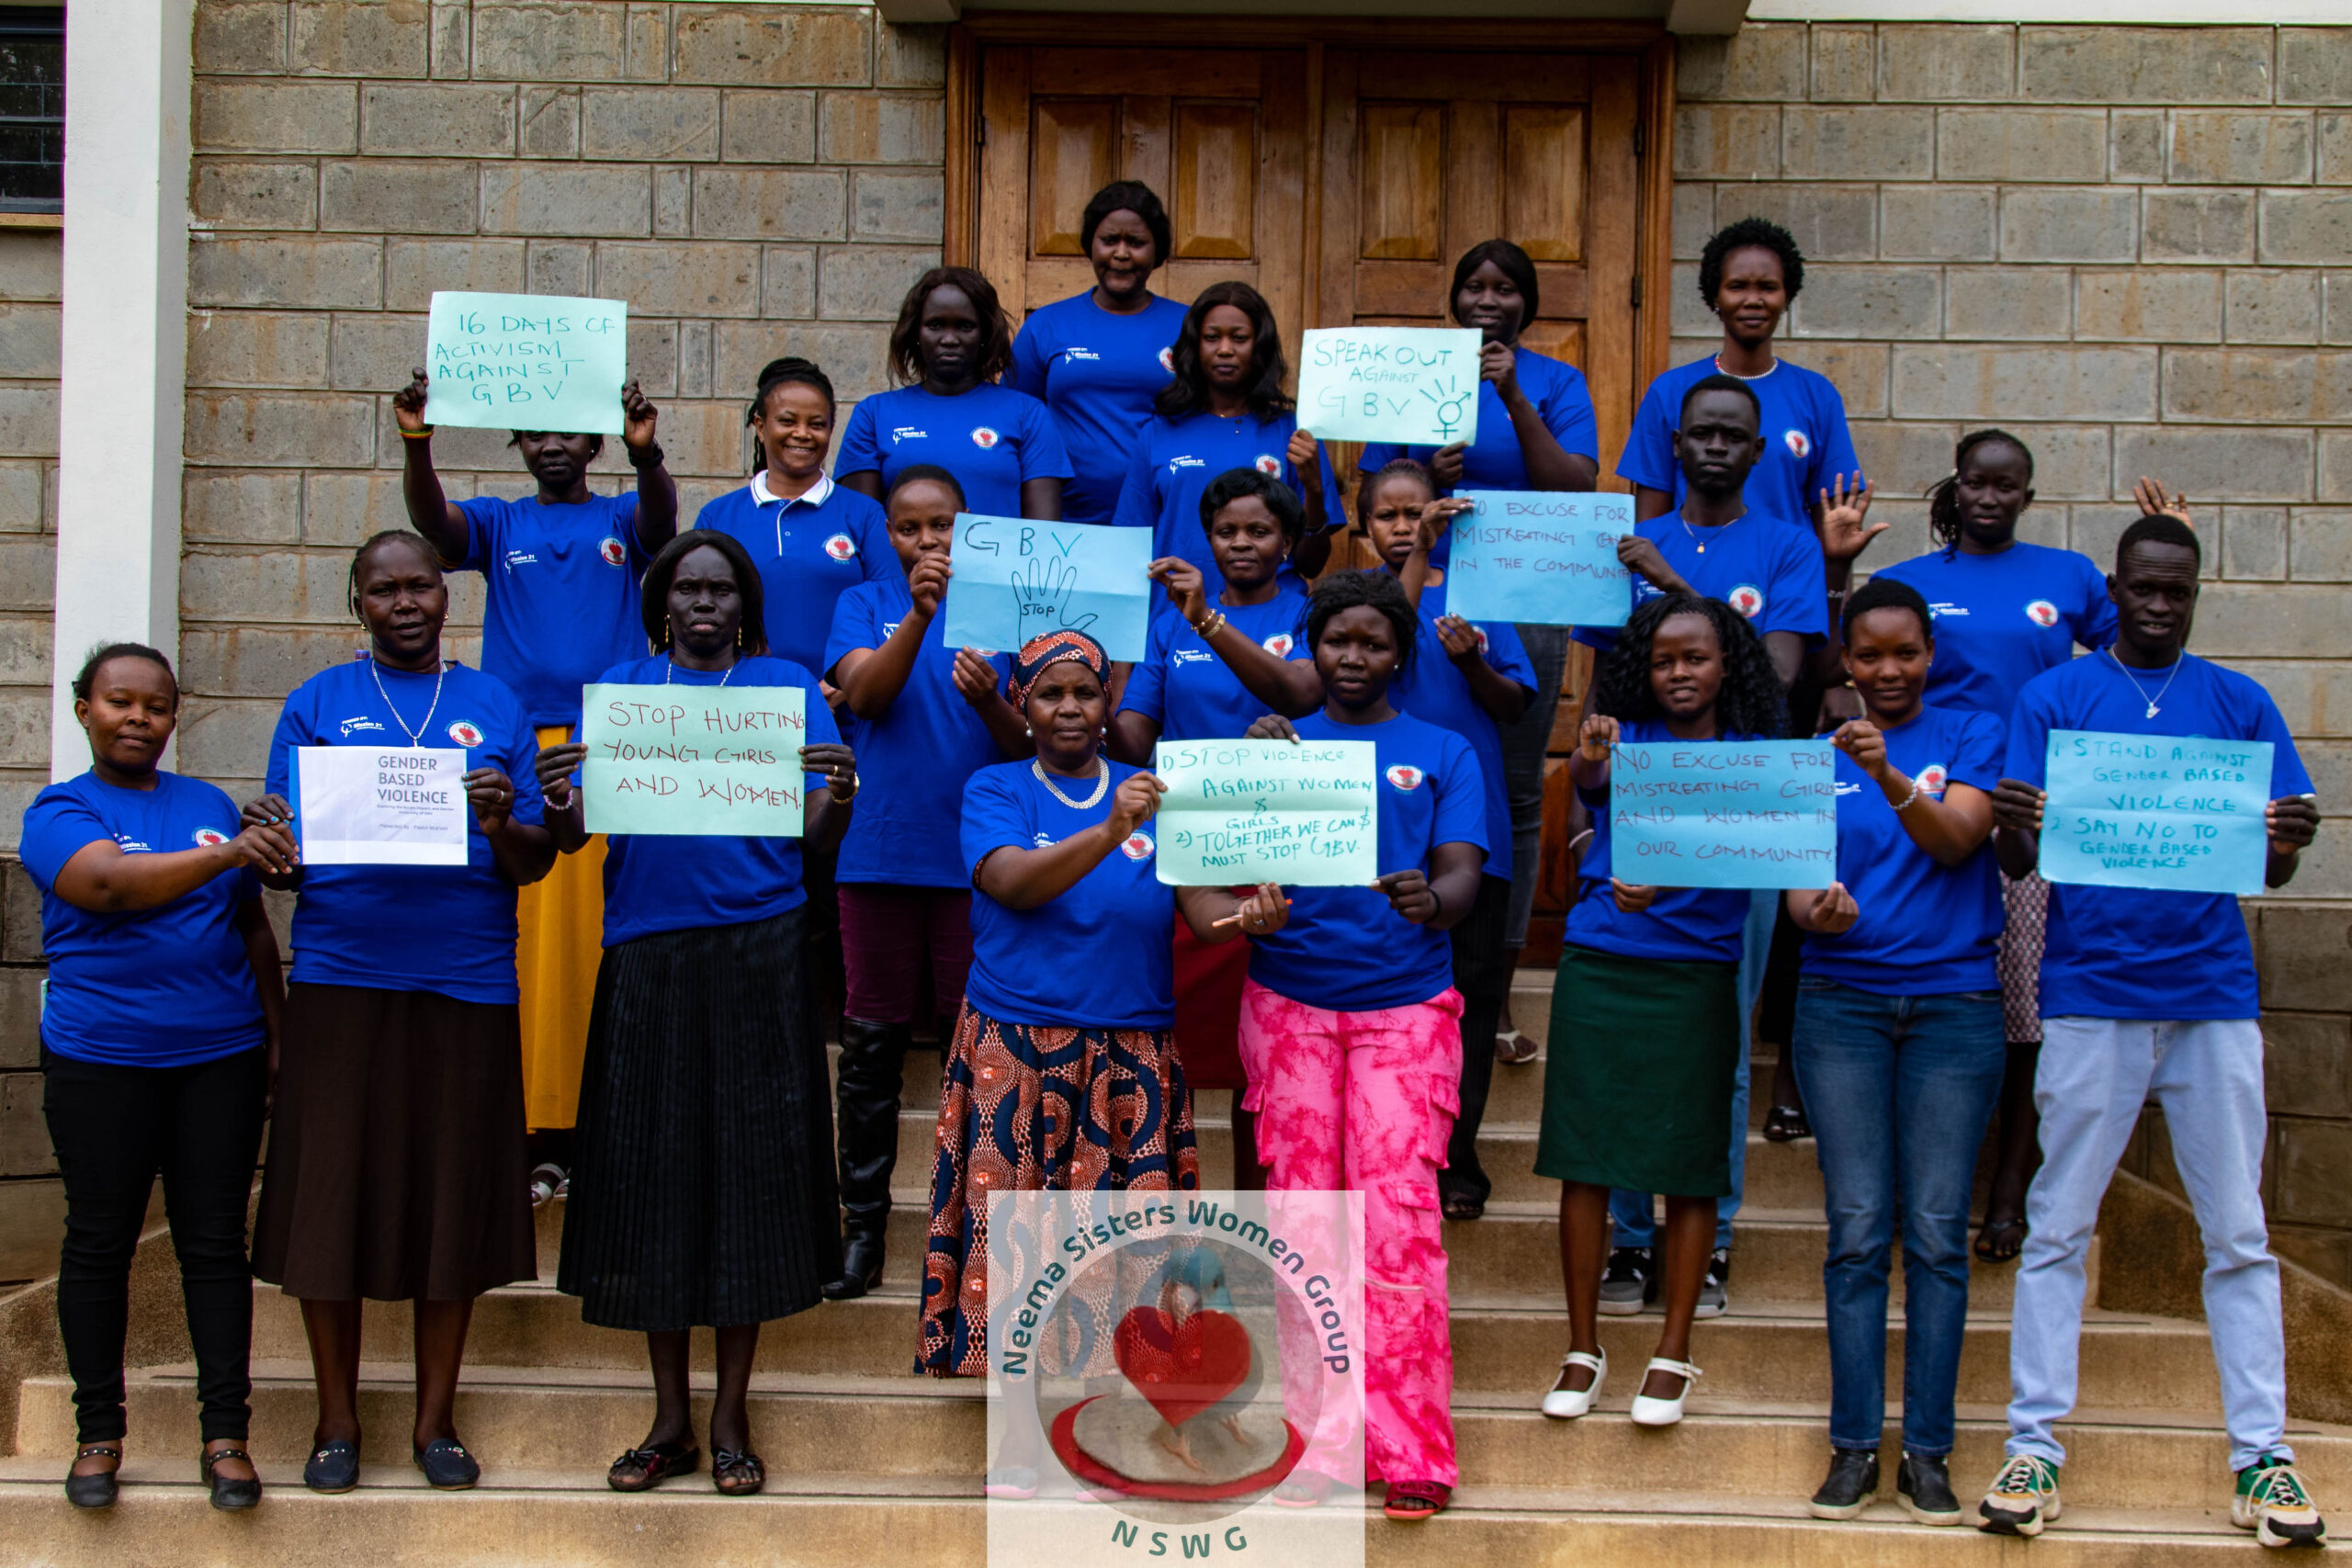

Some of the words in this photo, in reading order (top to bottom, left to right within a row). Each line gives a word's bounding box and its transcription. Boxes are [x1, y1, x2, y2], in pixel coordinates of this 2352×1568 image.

[460, 311, 485, 334] 16
[502, 316, 571, 334] DAYS
[435, 340, 561, 361] ACTIVISM
[1314, 339, 1389, 367] SPEAK
[1396, 347, 1453, 367] OUT
[439, 359, 584, 381] AGAINST
[1349, 367, 1419, 383] AGAINST
[1506, 502, 1579, 517] EXCUSE
[1594, 505, 1630, 523] FOR
[1456, 525, 1576, 546] MISTREATING
[1455, 558, 1478, 571] IN
[1493, 558, 1523, 570] THE
[1022, 604, 1056, 617] STOP
[608, 701, 685, 737] STOP
[704, 707, 805, 734] HURTING
[604, 739, 698, 763] YOUNG
[715, 748, 776, 765] GIRLS
[1261, 750, 1345, 762] VIOLENCE
[1615, 749, 1651, 773] NO
[1672, 751, 1771, 770] EXCUSE
[1791, 751, 1833, 770] FOR
[2074, 738, 2158, 759] STAND
[2171, 746, 2252, 767] AGAINST
[379, 755, 437, 771] GENDER
[379, 772, 425, 786] BASED
[616, 774, 679, 795] AND
[2184, 768, 2245, 783] BASED
[378, 789, 448, 805] VIOLENCE
[1203, 777, 1294, 799] AGAINST
[1298, 778, 1373, 792] WOMEN
[1616, 780, 1759, 798] MISTREATING
[2108, 794, 2236, 812] VIOLENCE
[1226, 816, 1280, 829] GIRLS
[1615, 806, 1676, 827] AND
[1704, 806, 1800, 825] WOMEN
[1816, 807, 1836, 824] IN
[1175, 829, 1193, 848] 2)
[1197, 825, 1293, 852] TOGETHER
[1298, 820, 1321, 839] WE
[1327, 818, 1355, 833] CAN
[2073, 817, 2118, 838] SAY
[2136, 821, 2176, 840] NO
[2192, 824, 2218, 840] TO
[1202, 852, 1247, 868] MUST
[1257, 842, 1301, 861] STOP
[1636, 840, 1682, 858] OUR
[2080, 840, 2152, 855] GENDER
[2159, 843, 2211, 855] BASED
[2101, 856, 2188, 870] VIOLENCE
